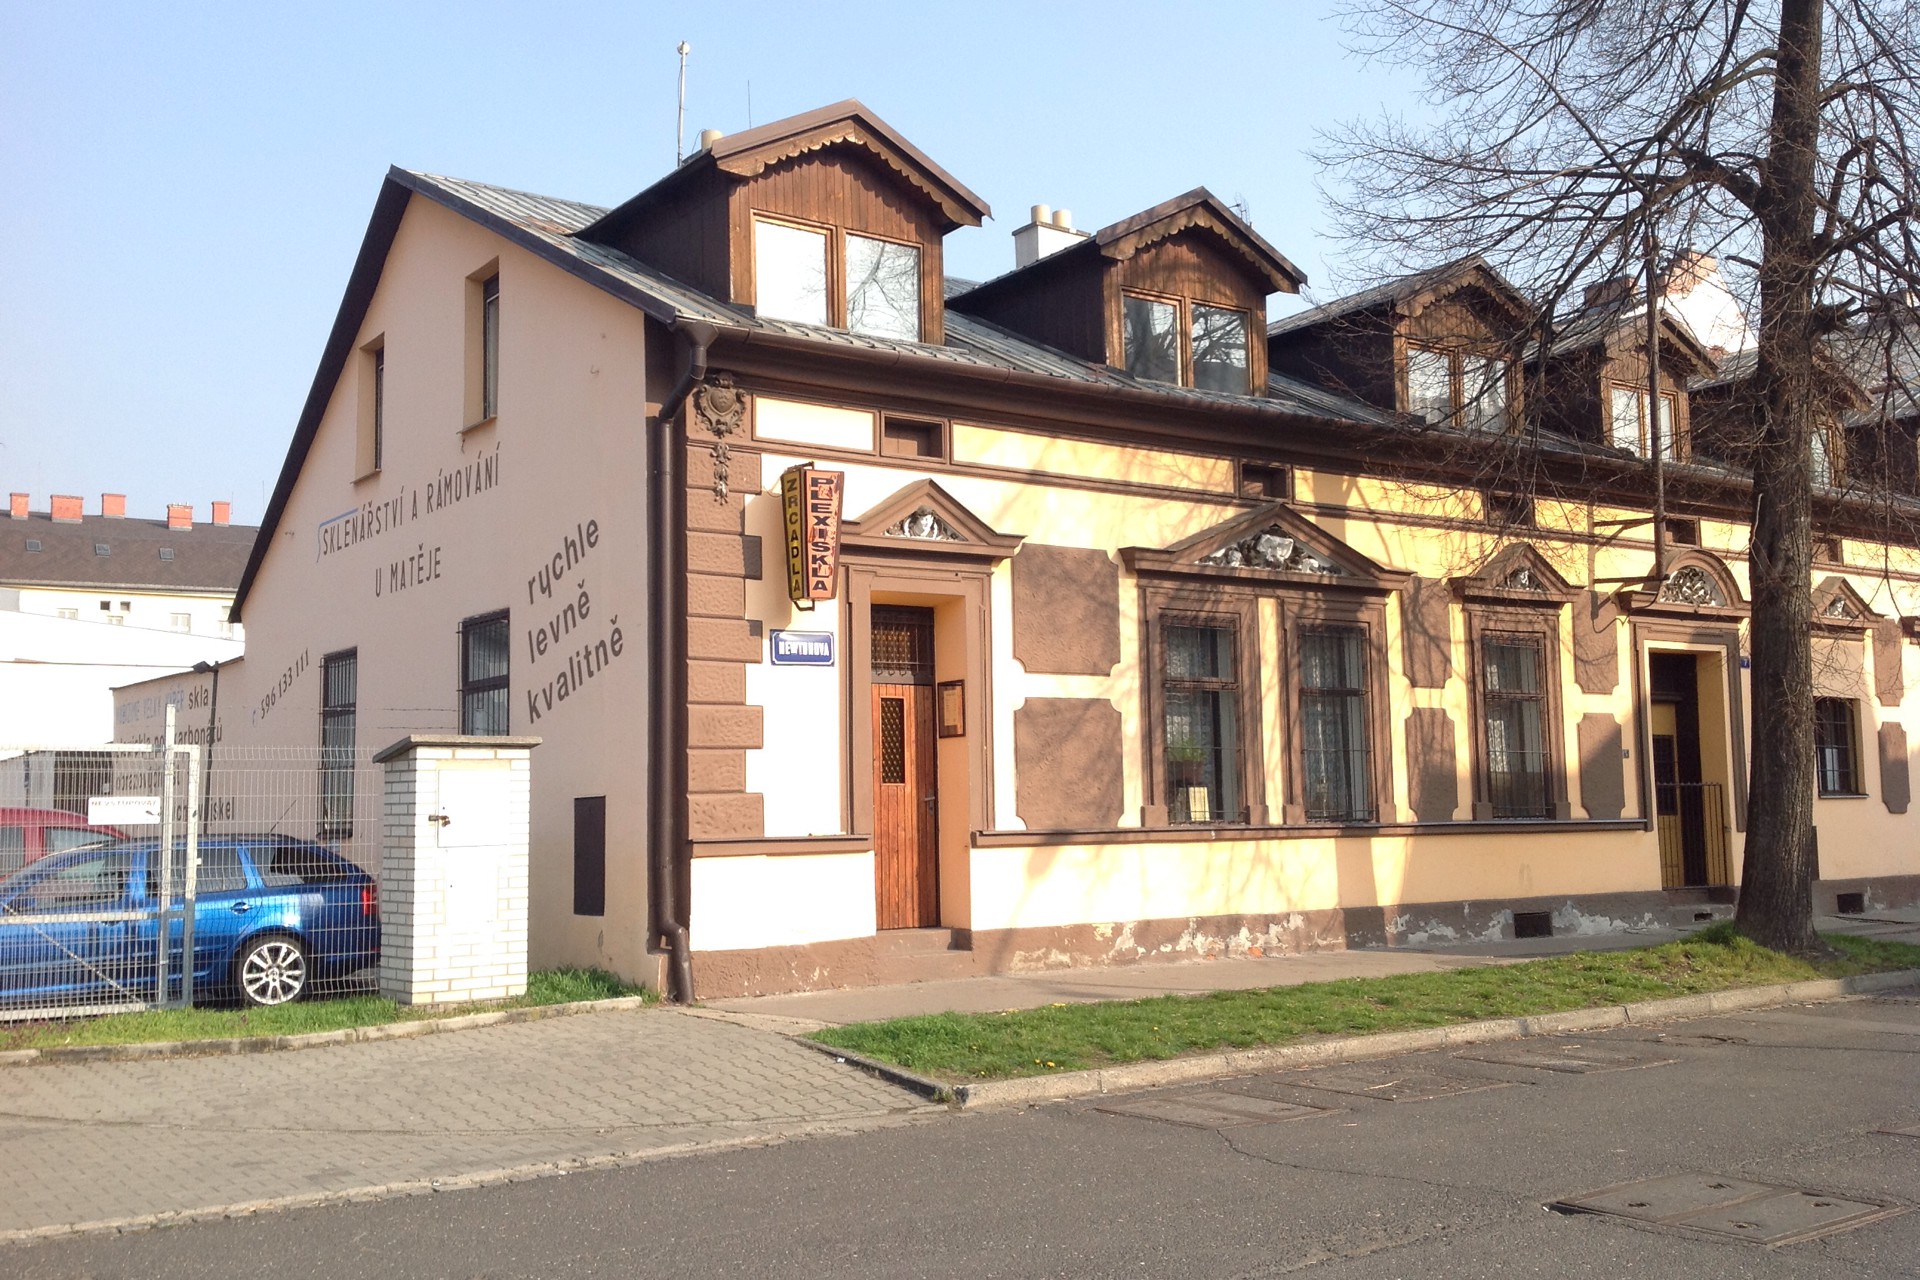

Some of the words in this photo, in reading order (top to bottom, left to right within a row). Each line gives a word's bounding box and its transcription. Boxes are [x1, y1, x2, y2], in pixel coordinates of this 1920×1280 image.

[322, 485, 405, 556] SKLENÁŘSTVÍ
[411, 490, 418, 521] A
[426, 441, 501, 514] RÁMOVÁNÍ
[786, 477, 801, 593] ZRCADLA
[810, 476, 834, 592] PLEXISKLA
[375, 568, 382, 598] U
[390, 542, 442, 594] MATĚJE
[528, 519, 599, 605] rychle
[528, 578, 591, 664] levně
[188, 684, 209, 710] skla
[260, 686, 277, 720] 596
[278, 666, 293, 698] 133
[295, 647, 309, 678] 111
[527, 614, 624, 724] kvalitně
